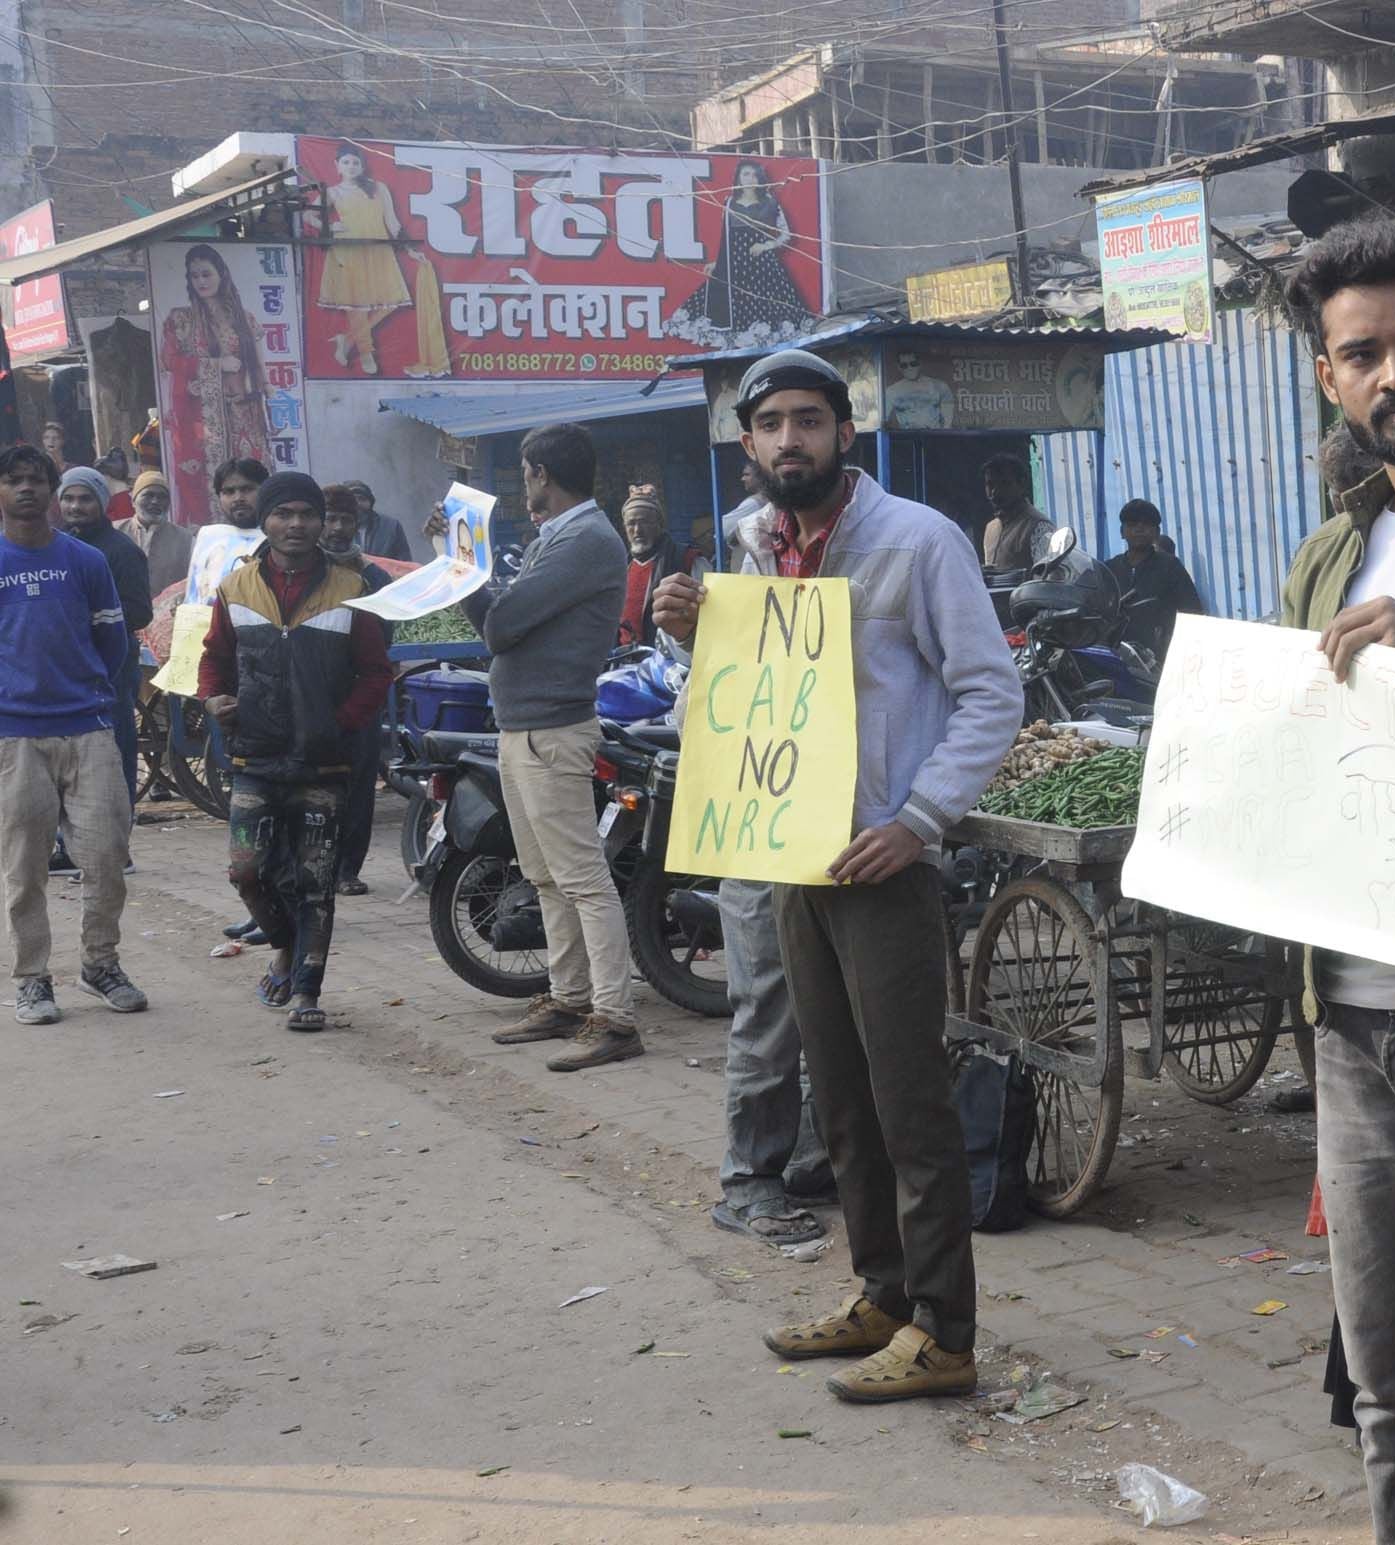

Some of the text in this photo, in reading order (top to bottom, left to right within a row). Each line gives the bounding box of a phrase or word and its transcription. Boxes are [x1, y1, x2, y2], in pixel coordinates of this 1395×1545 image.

[394, 145, 711, 260] राहत
[443, 267, 665, 340] कलेक्शन
[459, 353, 668, 372] 7081868772 734863
[0, 570, 68, 589] GIVENCHY
[758, 586, 825, 663] NO
[707, 664, 817, 733] CAB
[738, 736, 799, 797] NO
[695, 798, 792, 854] NRC
